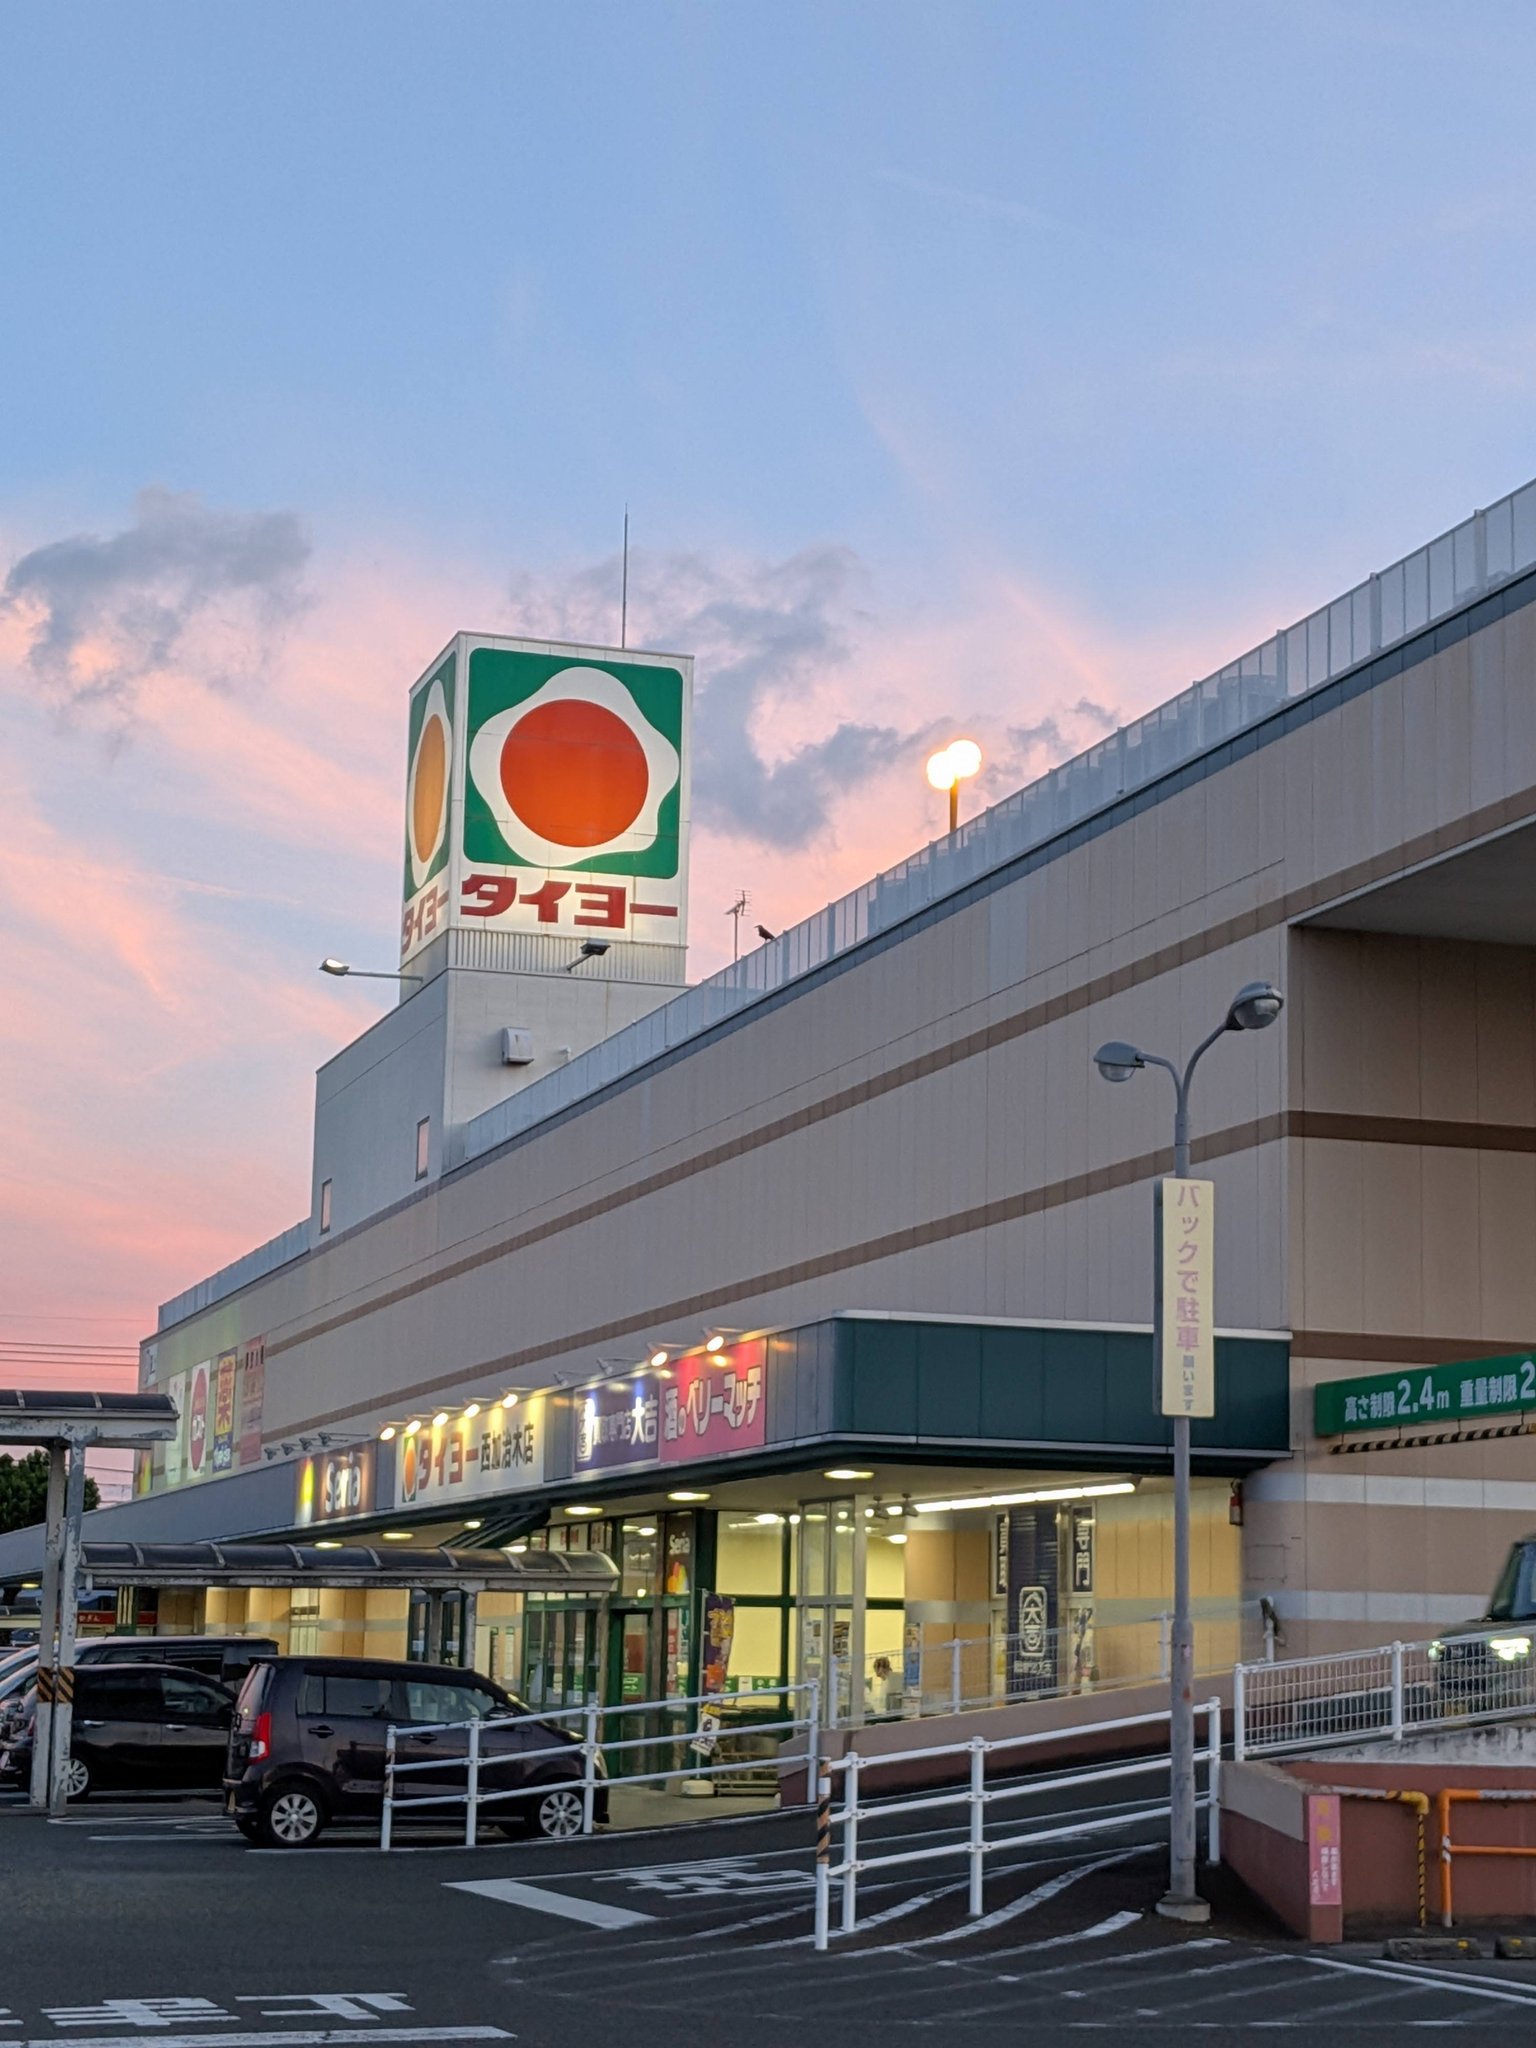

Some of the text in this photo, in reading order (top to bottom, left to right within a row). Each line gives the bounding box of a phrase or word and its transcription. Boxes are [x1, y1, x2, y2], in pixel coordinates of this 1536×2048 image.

[401, 885, 449, 955] タイヨー
[460, 873, 678, 929] タイヨー
[324, 1450, 362, 1513] Seria
[418, 1431, 479, 1490] タイヨー
[480, 1421, 534, 1472] 西加治木店
[0, 1992, 416, 2028] 止ま
